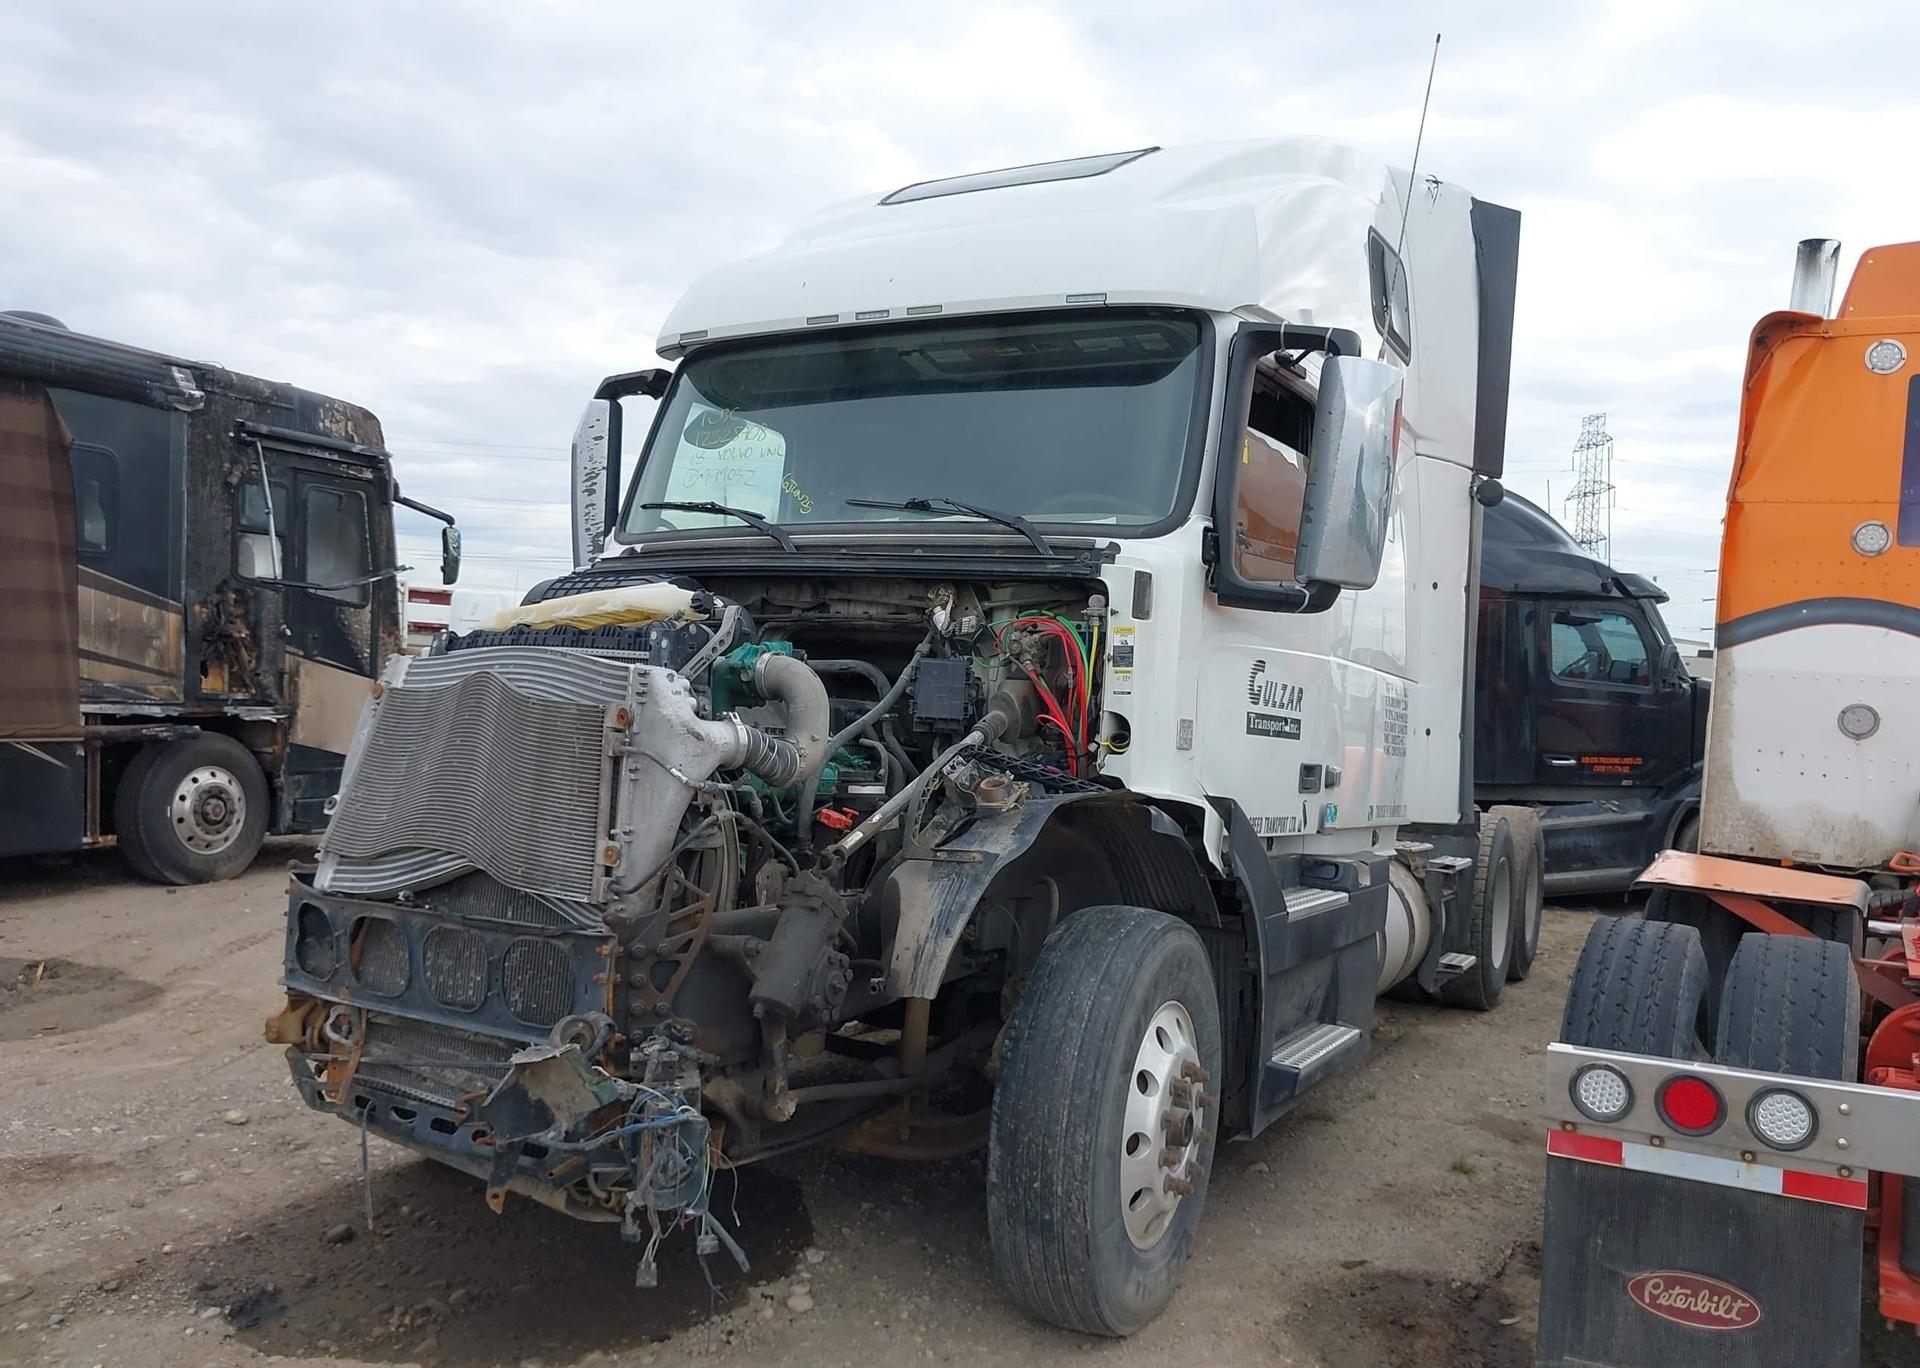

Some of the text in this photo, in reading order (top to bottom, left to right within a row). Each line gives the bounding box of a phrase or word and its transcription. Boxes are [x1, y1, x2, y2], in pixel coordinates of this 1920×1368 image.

[718, 446, 753, 461] VOLVO
[1247, 659, 1304, 713] GULZAR
[1248, 713, 1286, 736] Transport
[1263, 816, 1289, 834] TRANSPORT
[1643, 1277, 1750, 1321] Peterbilt
